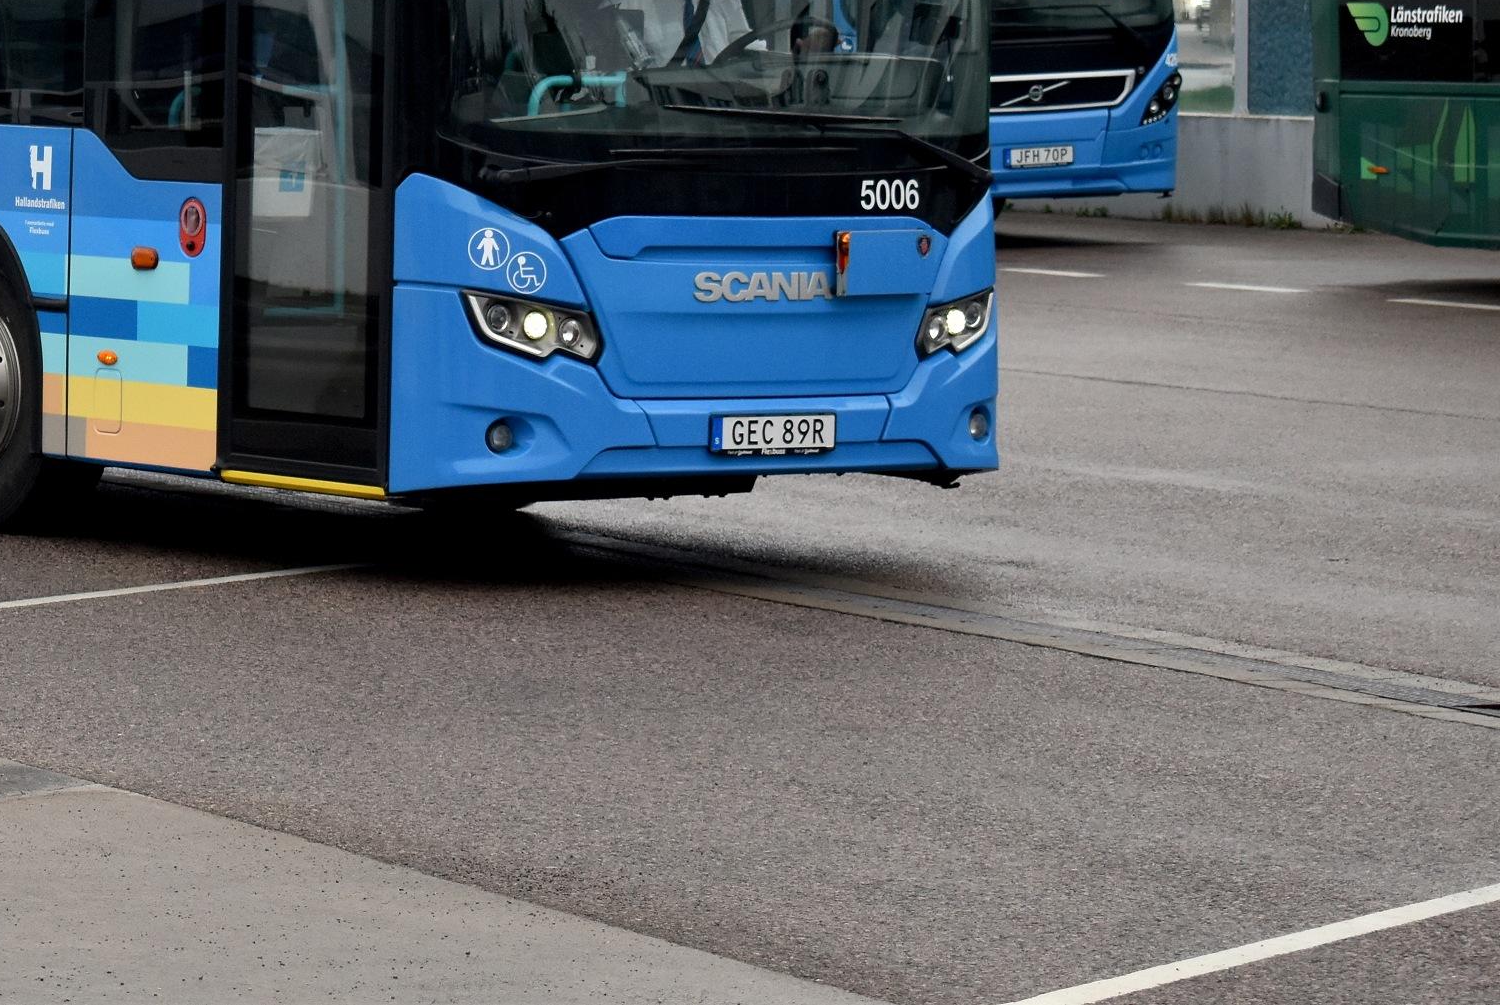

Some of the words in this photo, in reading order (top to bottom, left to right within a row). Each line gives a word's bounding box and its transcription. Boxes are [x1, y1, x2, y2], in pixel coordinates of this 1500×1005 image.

[1390, 5, 1463, 23] Länstrafiken
[1390, 25, 1432, 40] Kronoberg
[1016, 150, 1040, 164] JFH
[1044, 148, 1068, 162] 70P
[29, 145, 53, 191] H
[15, 196, 66, 210] Hallandstrafiken
[860, 179, 920, 211] 5006
[693, 270, 834, 302] SCANIA
[732, 419, 774, 445] GEC
[782, 418, 824, 444] 89R
